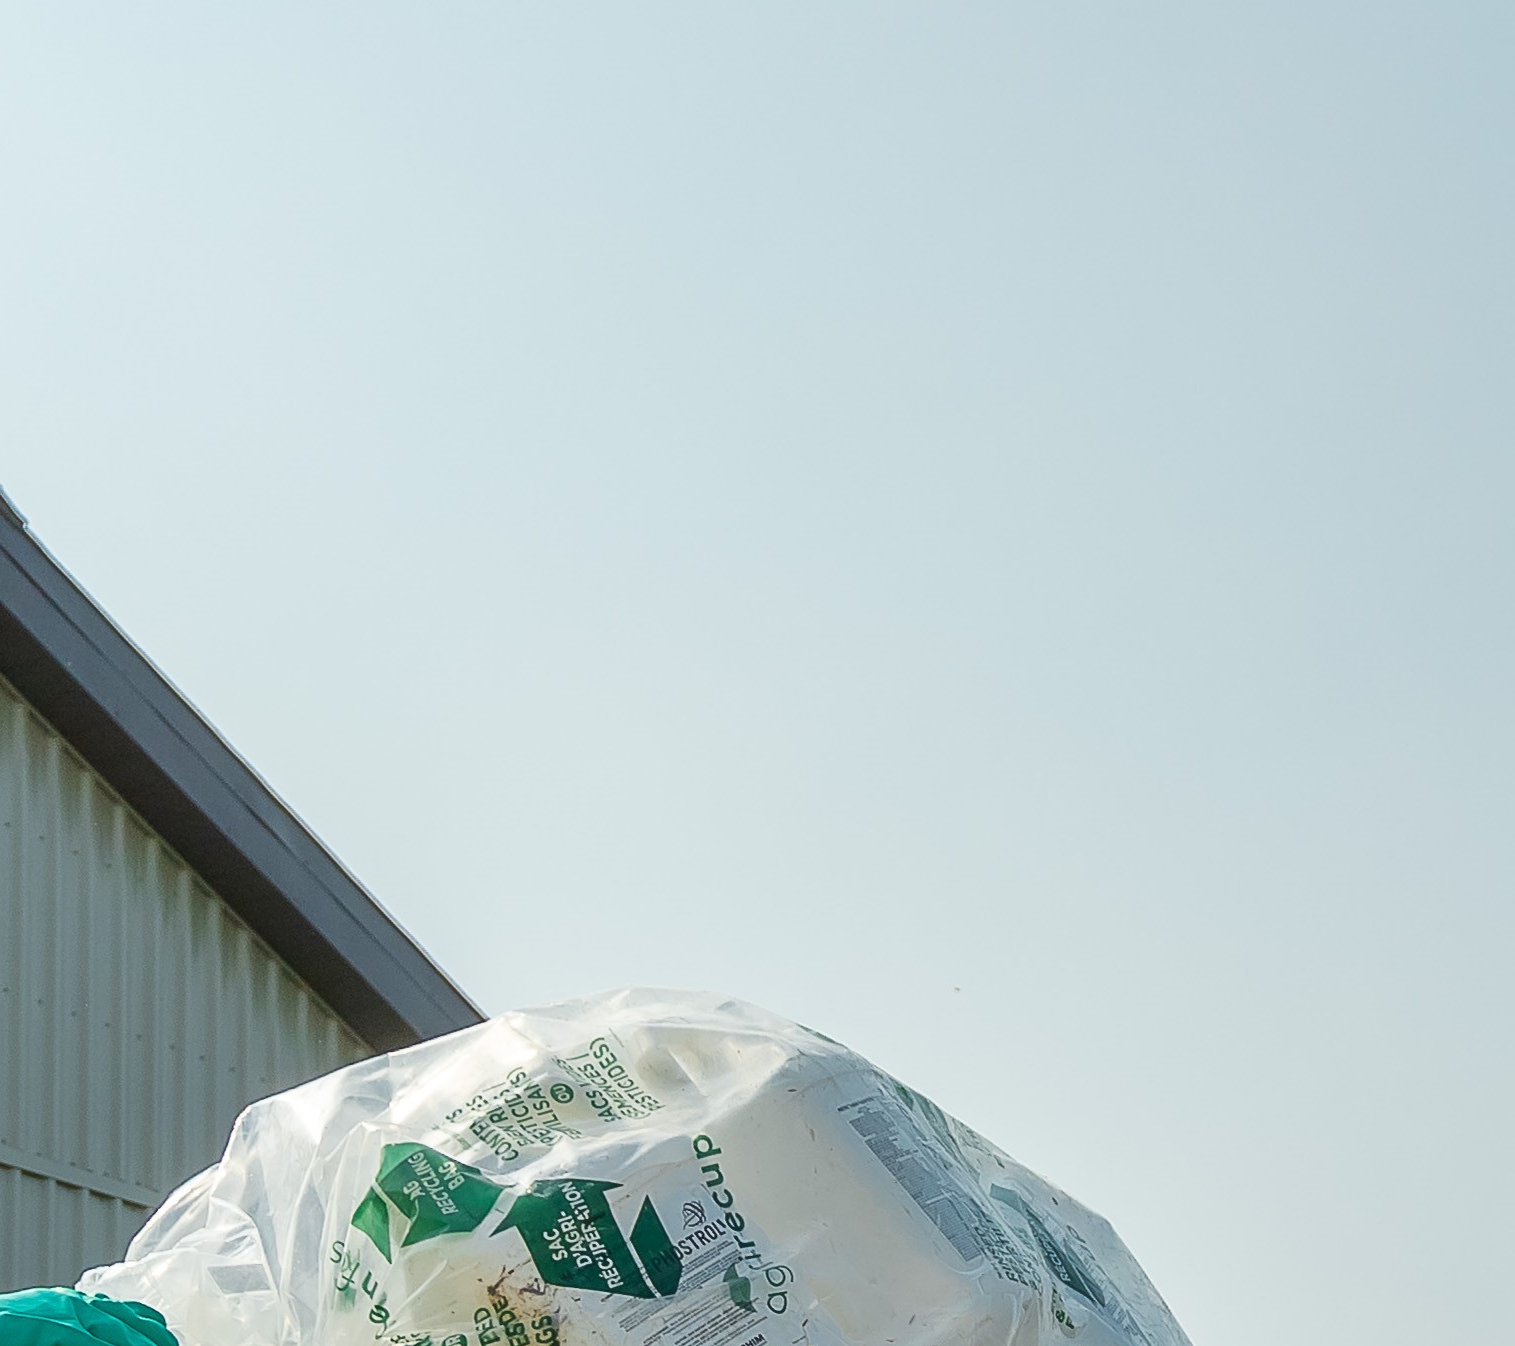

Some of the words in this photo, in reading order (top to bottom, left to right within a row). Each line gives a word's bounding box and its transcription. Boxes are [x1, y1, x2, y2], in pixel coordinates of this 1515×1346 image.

[407, 1150, 460, 1216] RECYCLING
[438, 1161, 466, 1191] BAG
[543, 1228, 569, 1262] SAC
[652, 1219, 724, 1274] PHOSTROL
